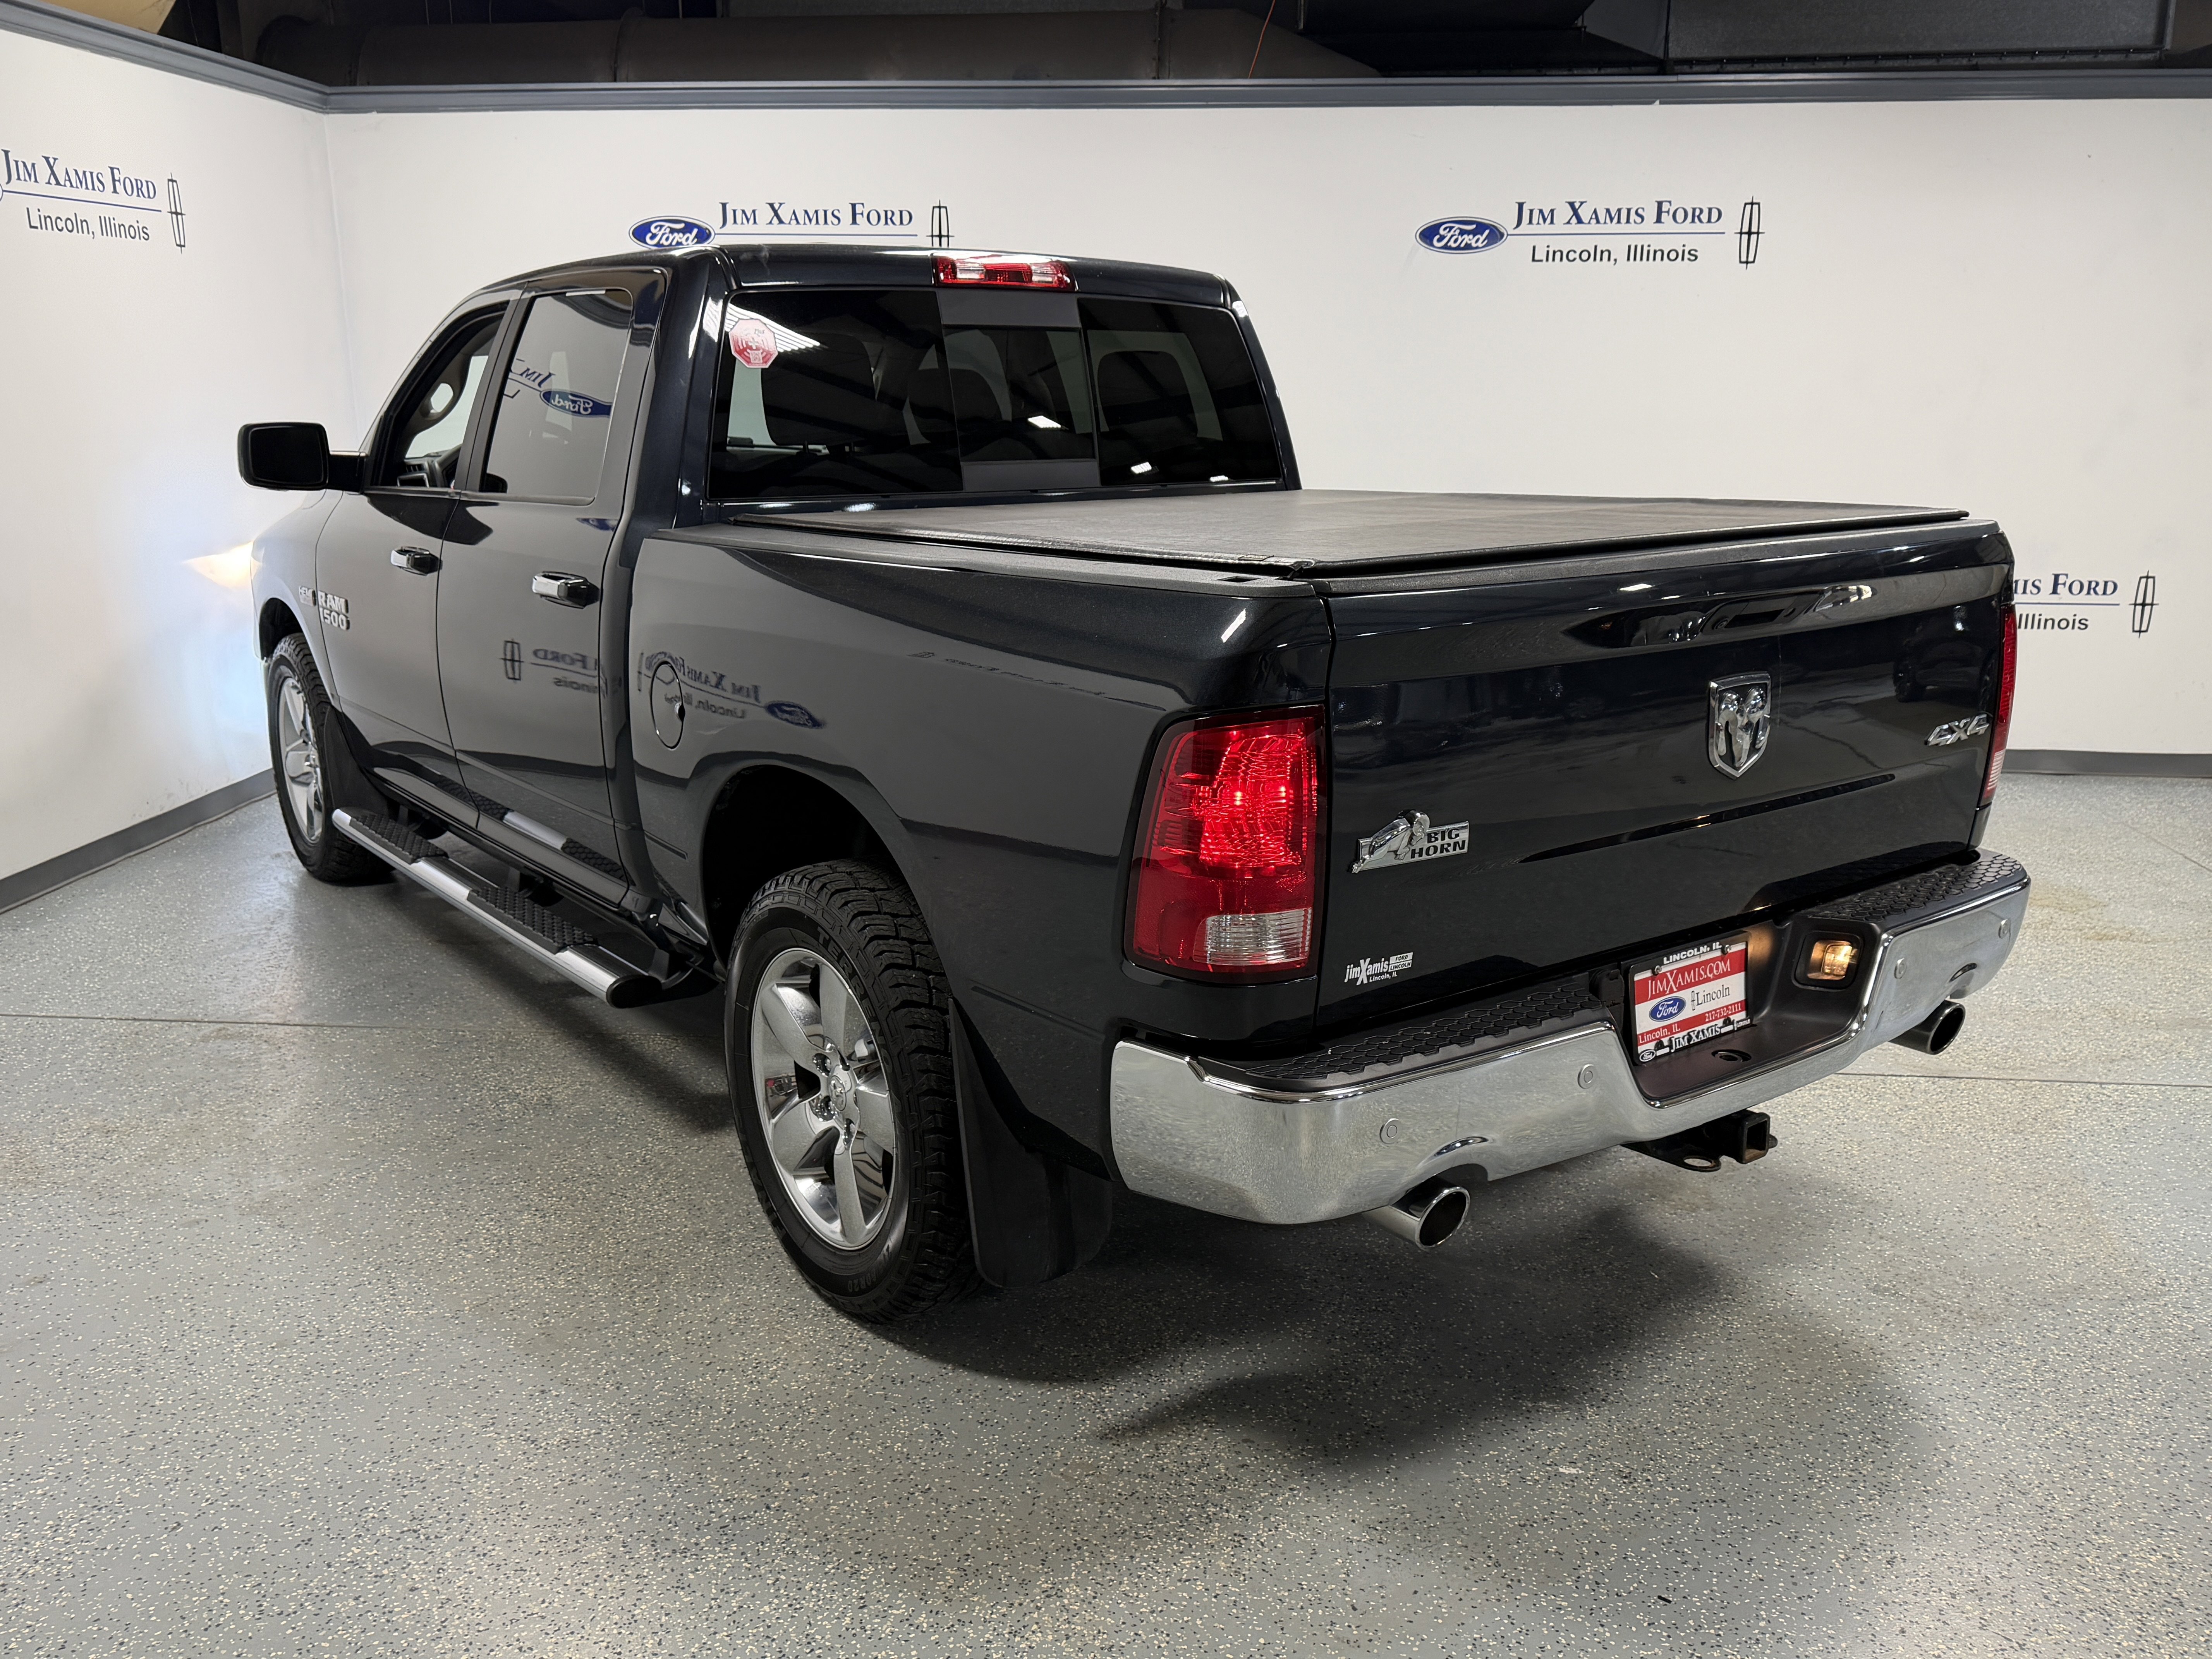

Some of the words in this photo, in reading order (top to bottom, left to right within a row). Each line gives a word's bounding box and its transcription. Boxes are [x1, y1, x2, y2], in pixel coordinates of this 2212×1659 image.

[1, 149, 39, 185] JIM
[41, 155, 105, 192] XAMIS
[108, 166, 156, 199] FORD
[26, 207, 95, 239] Lincoln,
[99, 215, 150, 241] Illinois
[719, 202, 758, 229] JIM
[765, 202, 841, 226] XAMIS
[849, 202, 913, 226] FORD
[1513, 201, 1556, 230] JIM
[1563, 200, 1645, 225] XAMIS
[1653, 200, 1723, 225] FORD
[646, 222, 698, 245] Ford
[1433, 222, 1489, 248] Ford
[1532, 244, 1618, 266] Lincoln,
[1626, 244, 1698, 262] Illinois
[2049, 573, 2118, 596] FORD
[318, 590, 347, 614] RAM
[319, 607, 349, 630] 1500
[2018, 613, 2089, 630] Illinois
[1427, 828, 1460, 844] BIG
[1411, 840, 1466, 860] HORN
[1390, 962, 1411, 970] LINCOLN
[1664, 945, 1710, 965] LINCOLN,
[1696, 984, 1730, 1006] Lincoln
[1657, 1000, 1679, 1018] Ford
[1705, 1003, 1741, 1022] 217-732-2111
[1671, 1037, 1688, 1052] JIM
[1690, 1025, 1721, 1044] XAMIS
[1673, 1024, 1680, 1032] IL
